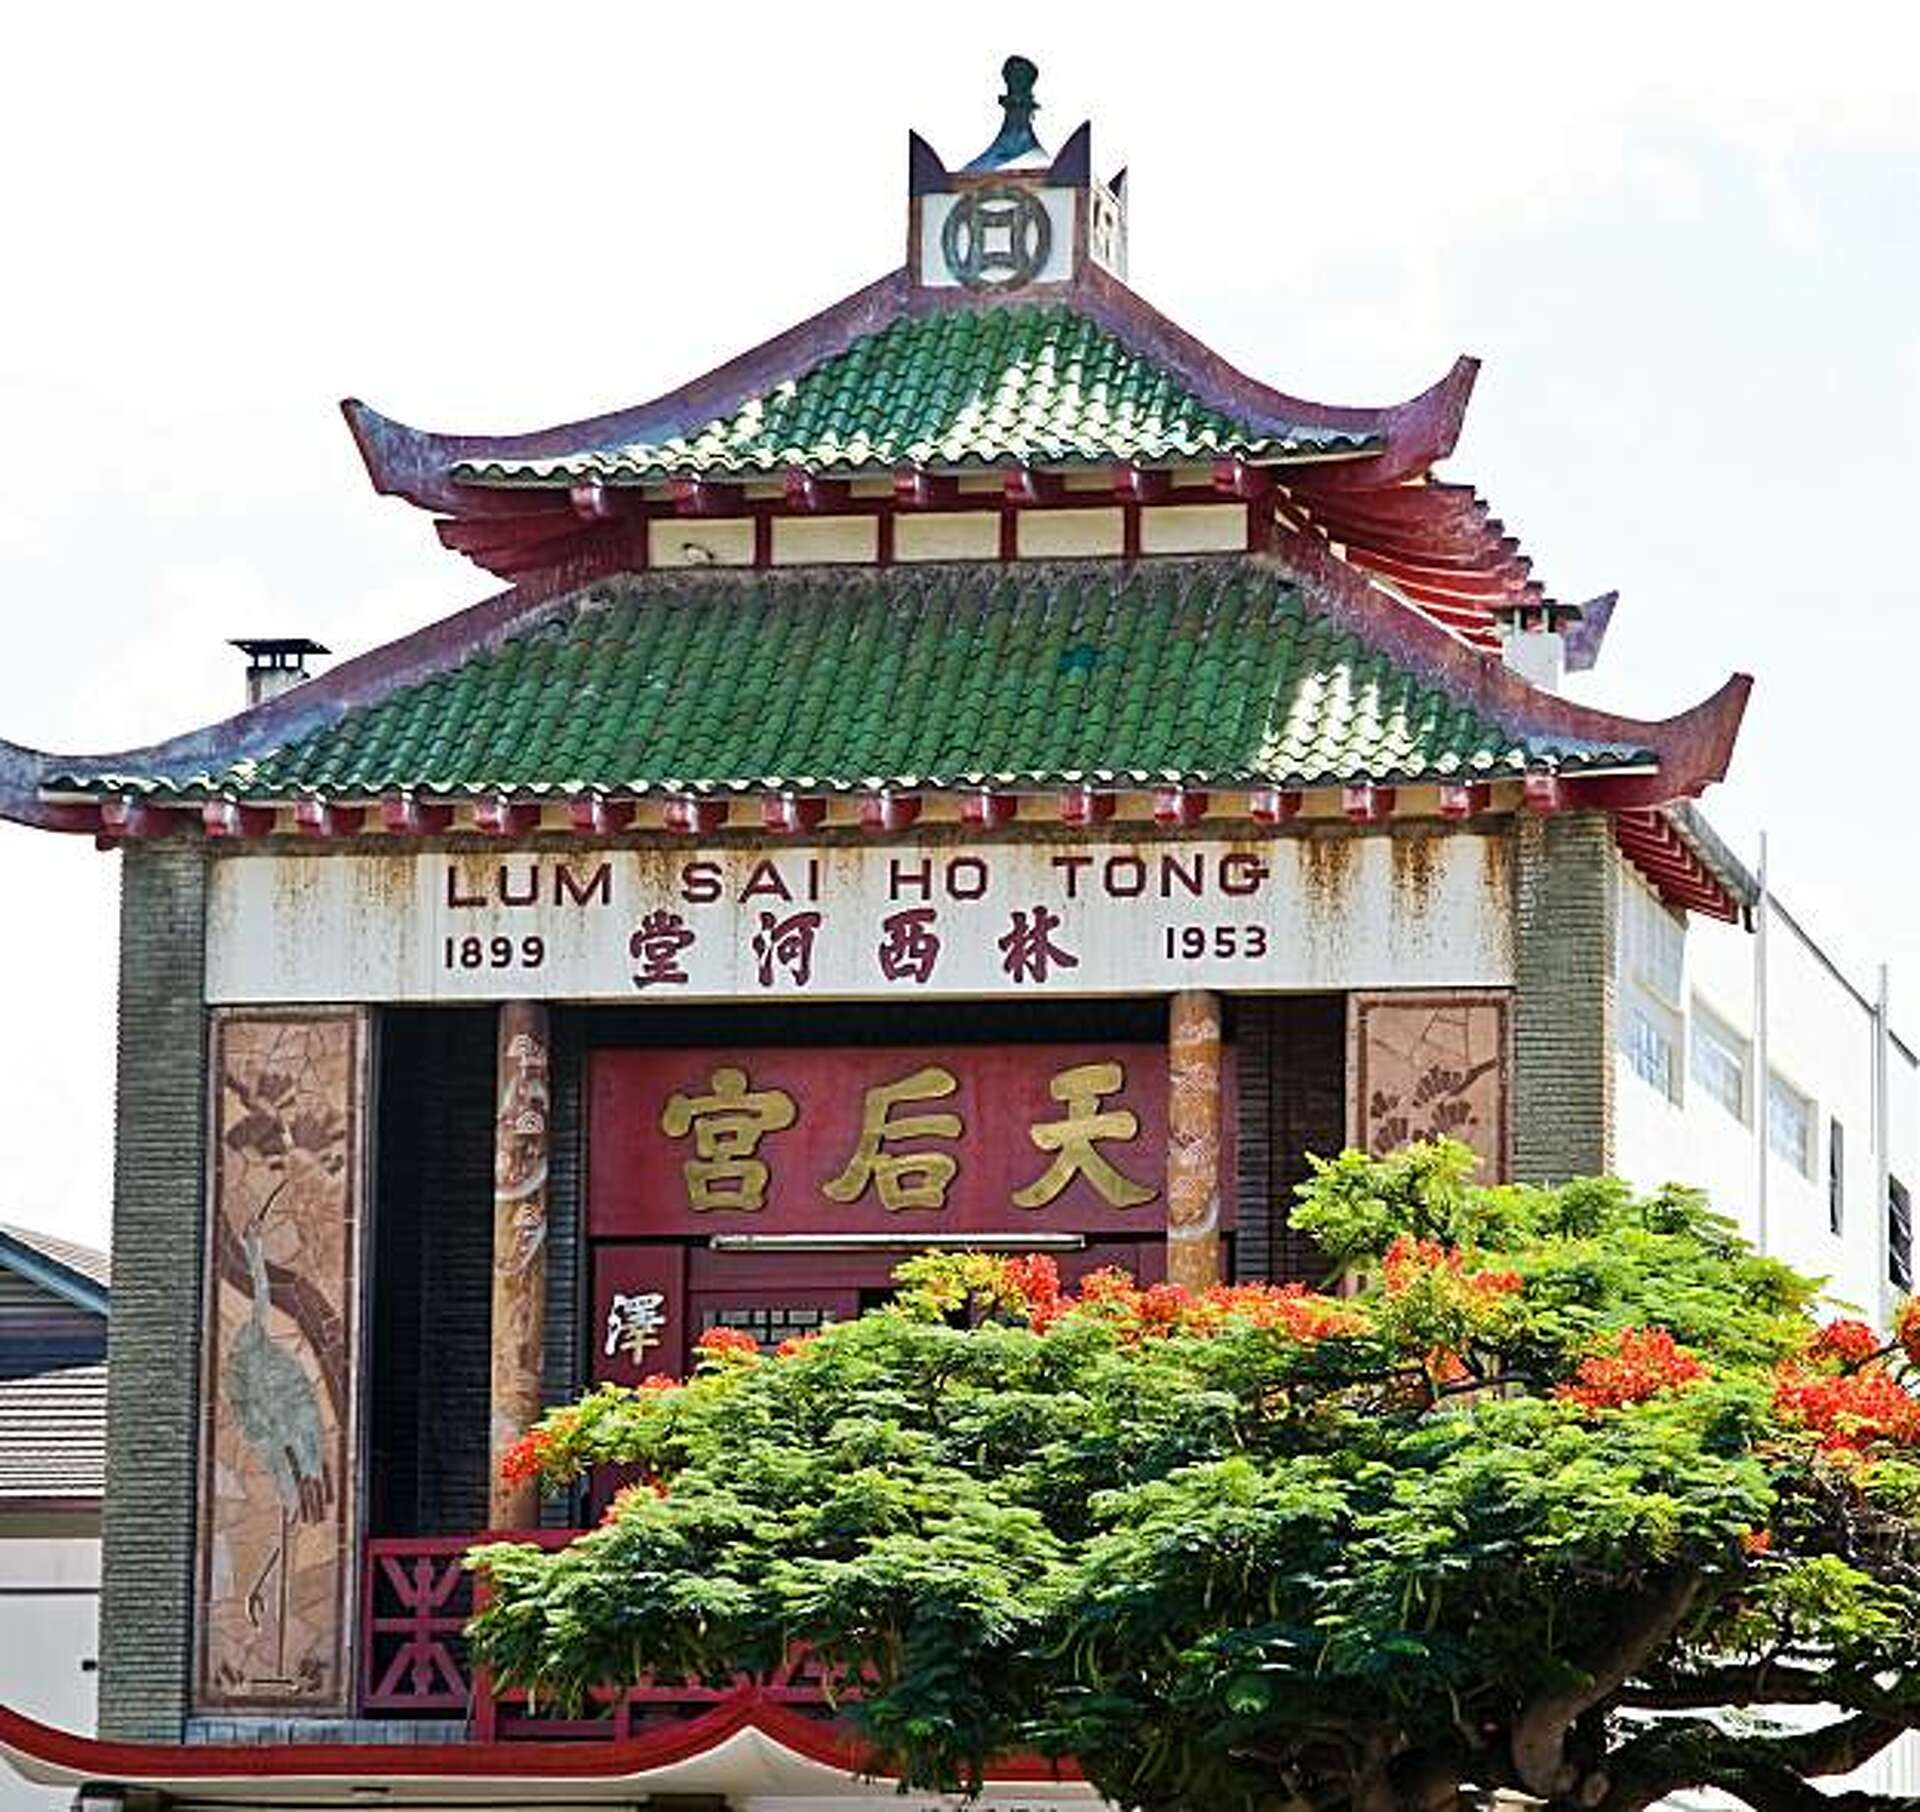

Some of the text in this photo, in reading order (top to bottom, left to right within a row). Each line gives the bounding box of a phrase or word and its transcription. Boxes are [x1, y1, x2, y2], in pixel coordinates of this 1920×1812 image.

[447, 853, 1270, 908] LUM SAI HO TONG
[445, 936, 545, 969] 1899
[1165, 926, 1268, 958] 1953
[605, 1292, 666, 1365] 澤
